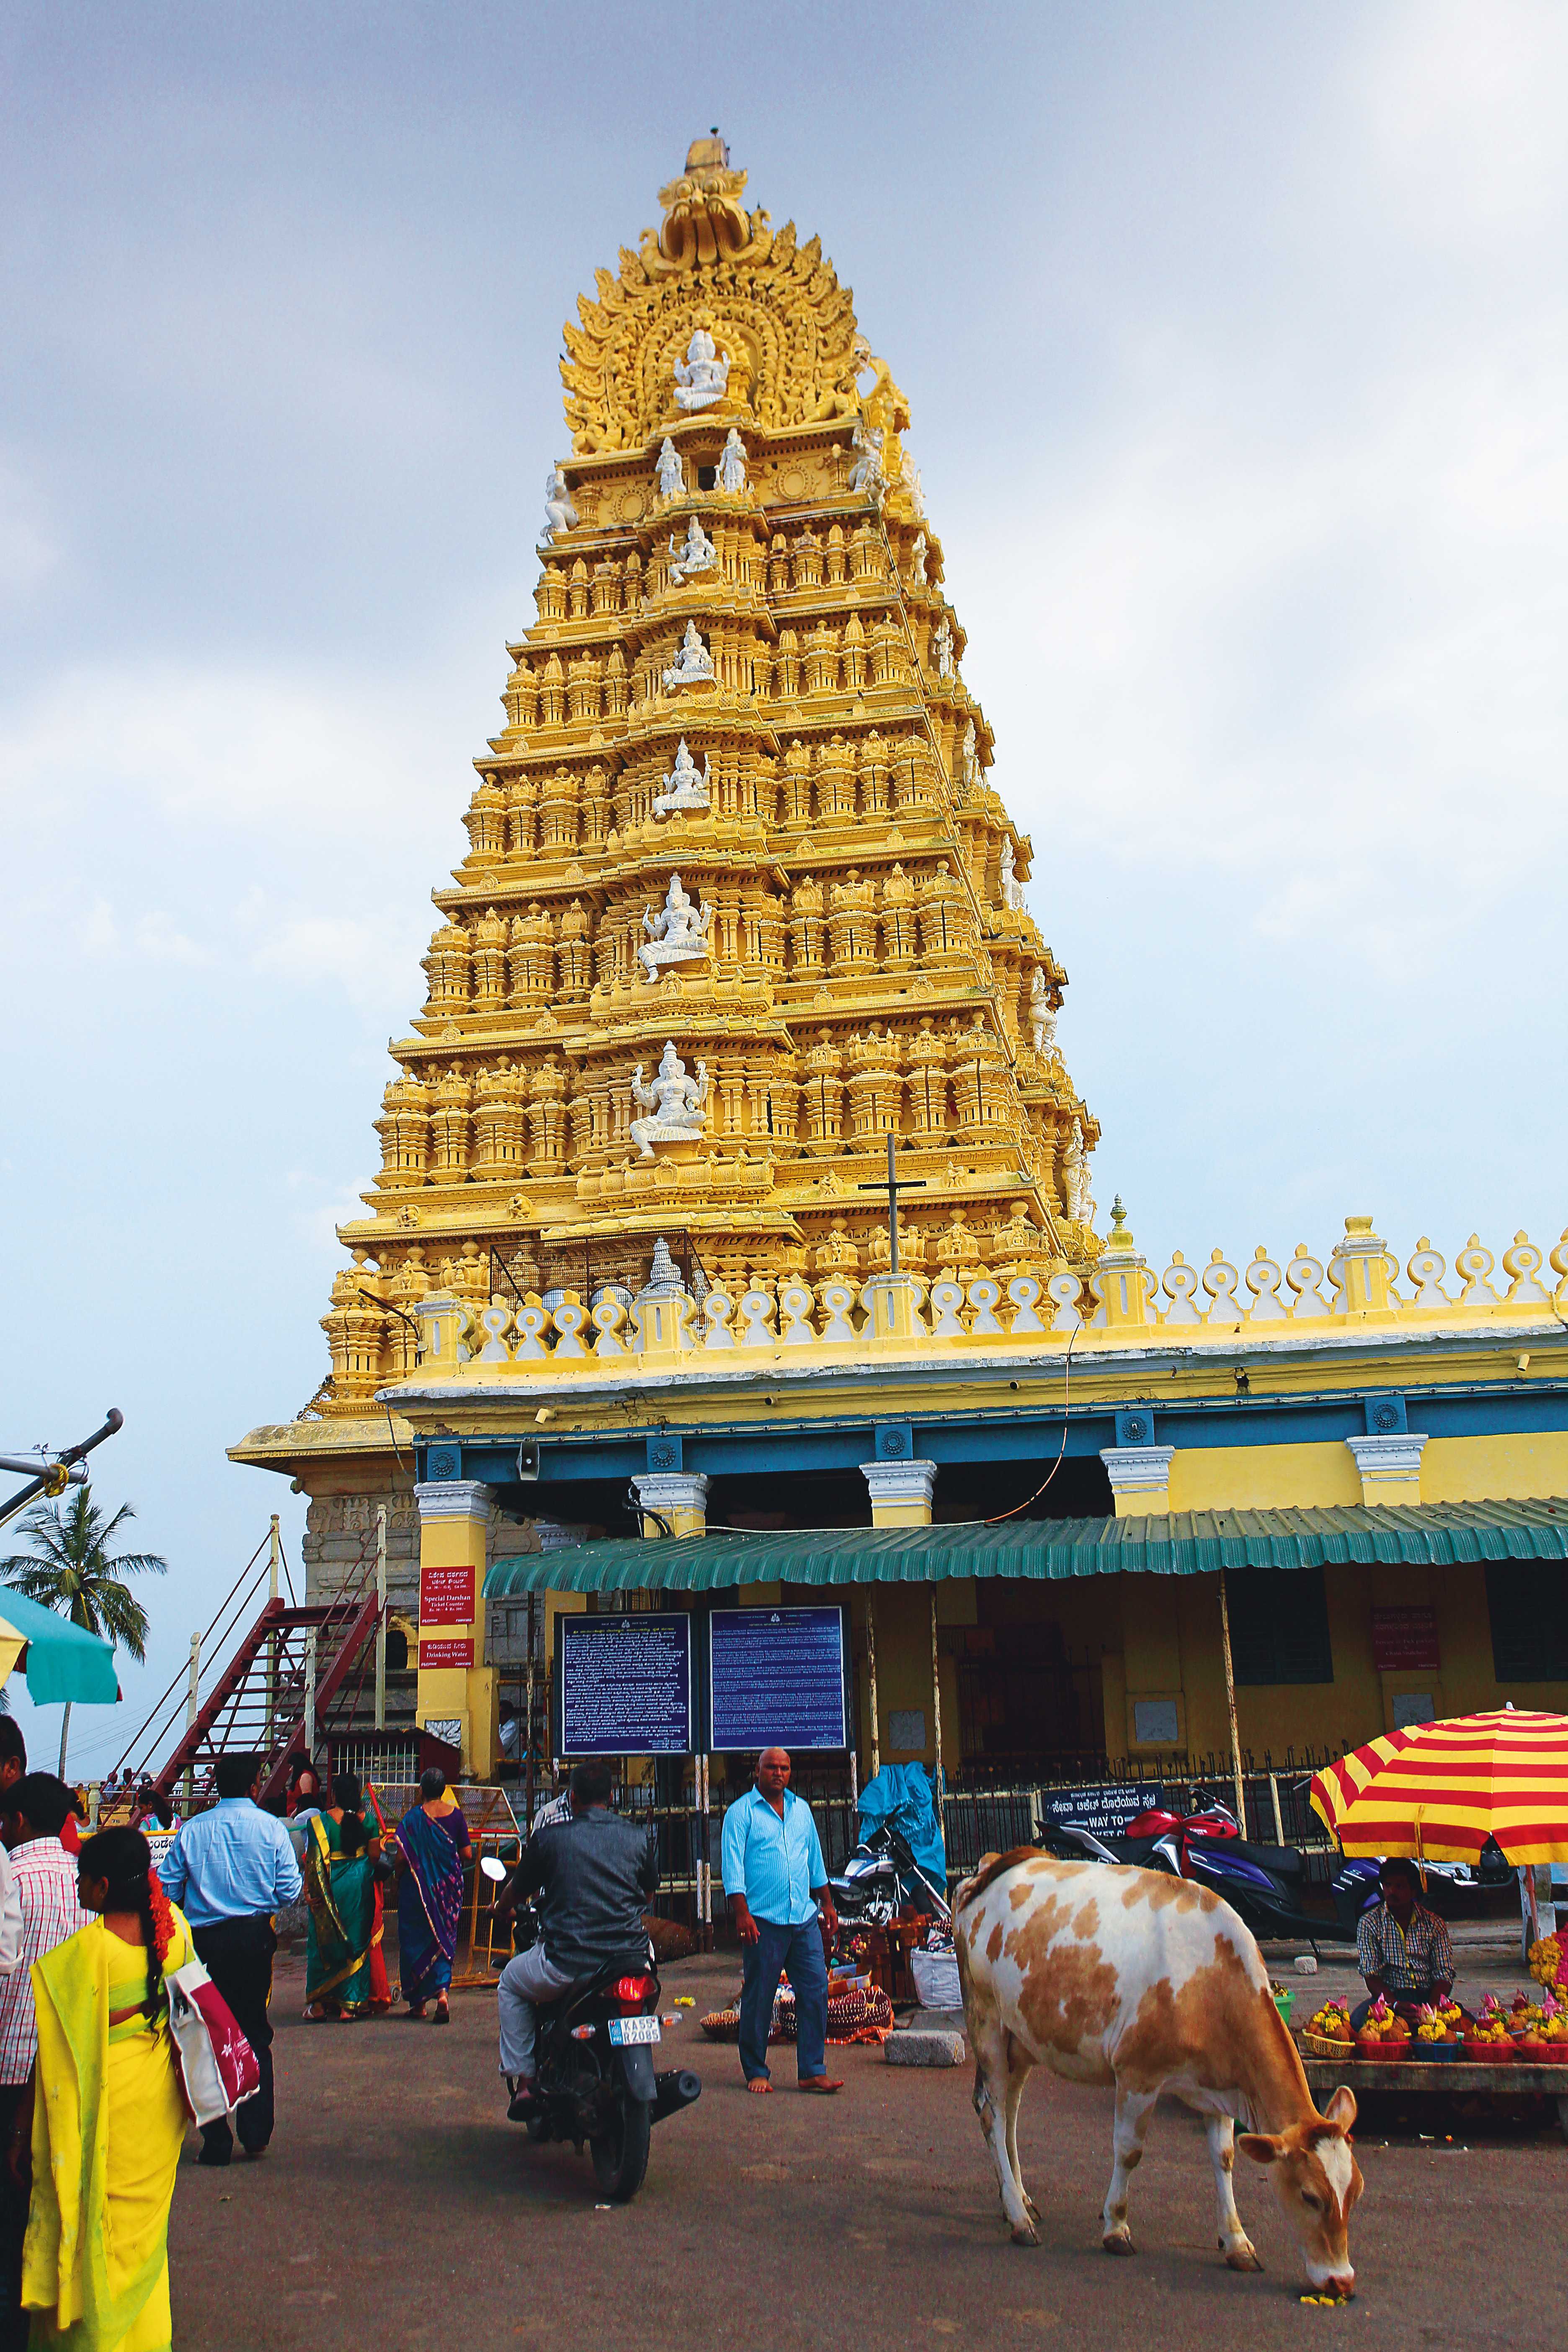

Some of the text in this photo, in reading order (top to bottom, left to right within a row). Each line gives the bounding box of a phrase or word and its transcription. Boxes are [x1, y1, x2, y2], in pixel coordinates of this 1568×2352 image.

[425, 1595, 445, 1603] Special
[1089, 1815, 1124, 1828] WAY TO
[624, 2018, 652, 2032] KA55
